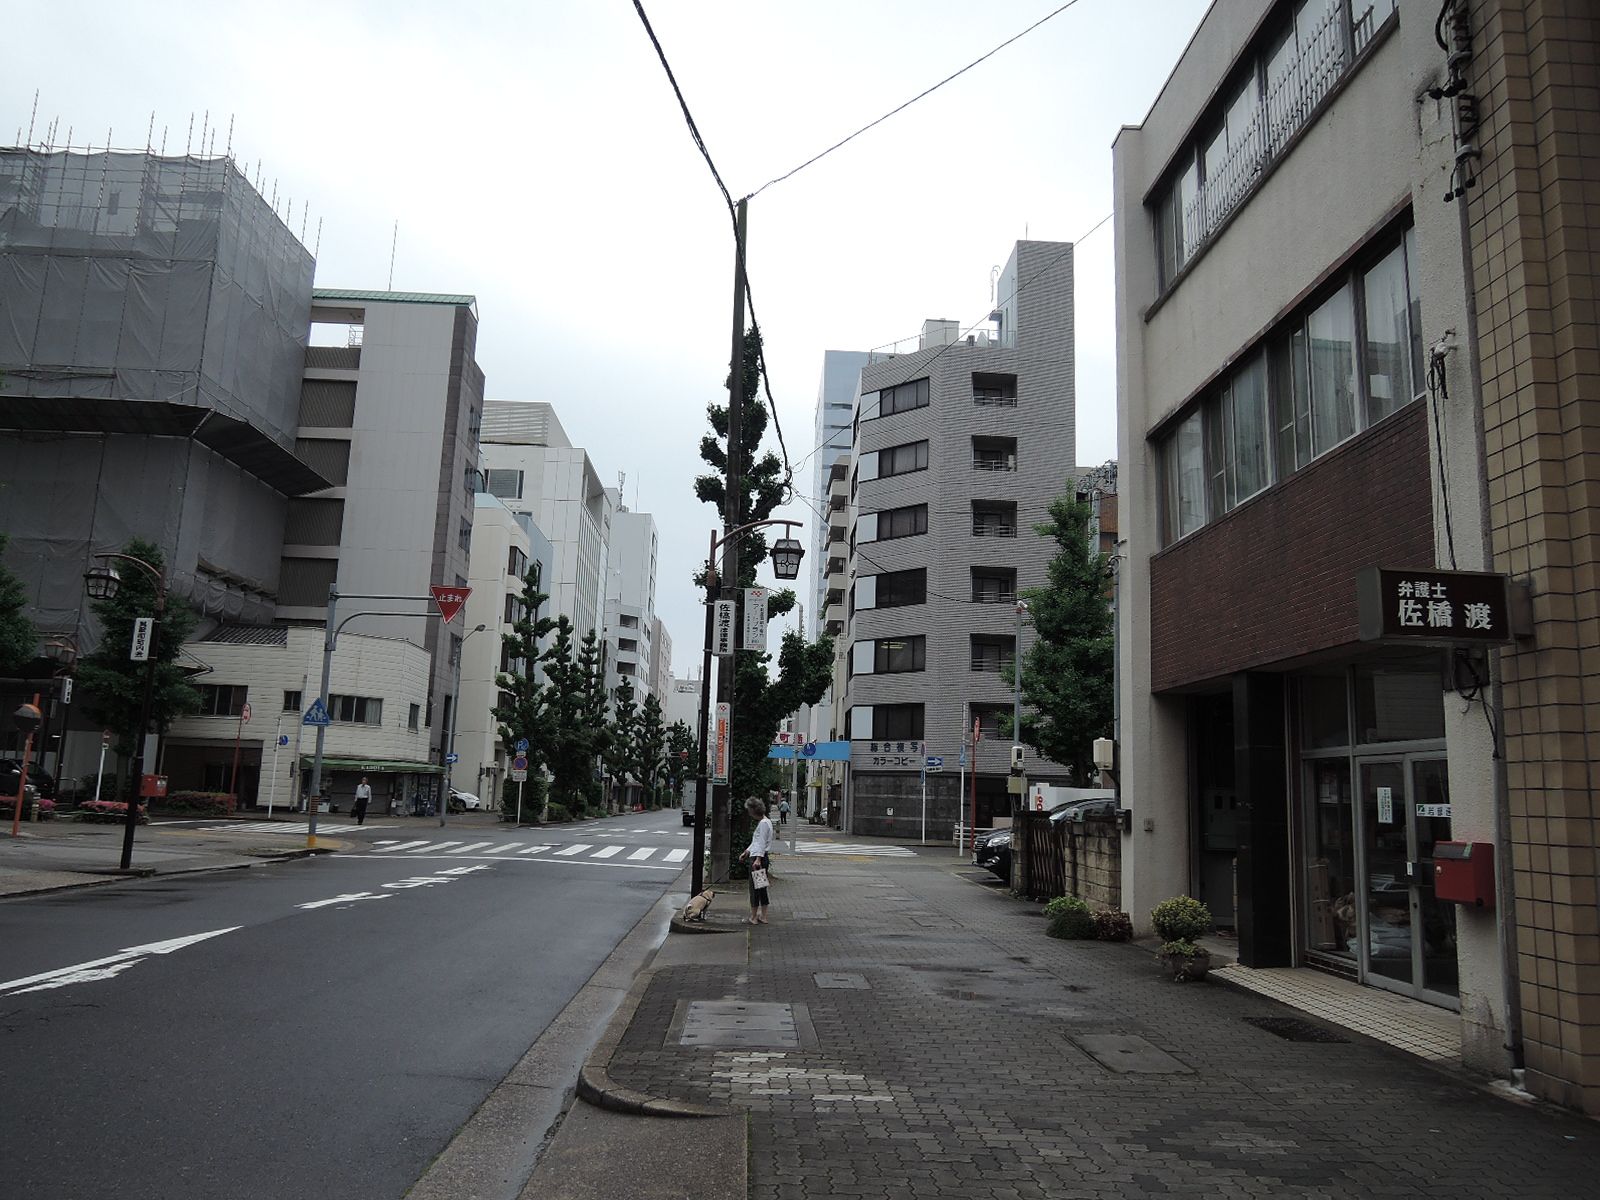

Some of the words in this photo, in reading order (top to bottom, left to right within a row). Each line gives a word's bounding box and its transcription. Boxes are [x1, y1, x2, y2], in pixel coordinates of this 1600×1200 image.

[1397, 580, 1447, 600] 弁護士
[437, 593, 463, 603] 止まれ
[1398, 599, 1453, 627] 佐橋
[1464, 602, 1493, 630] 渡
[872, 756, 916, 766] カラーコピー
